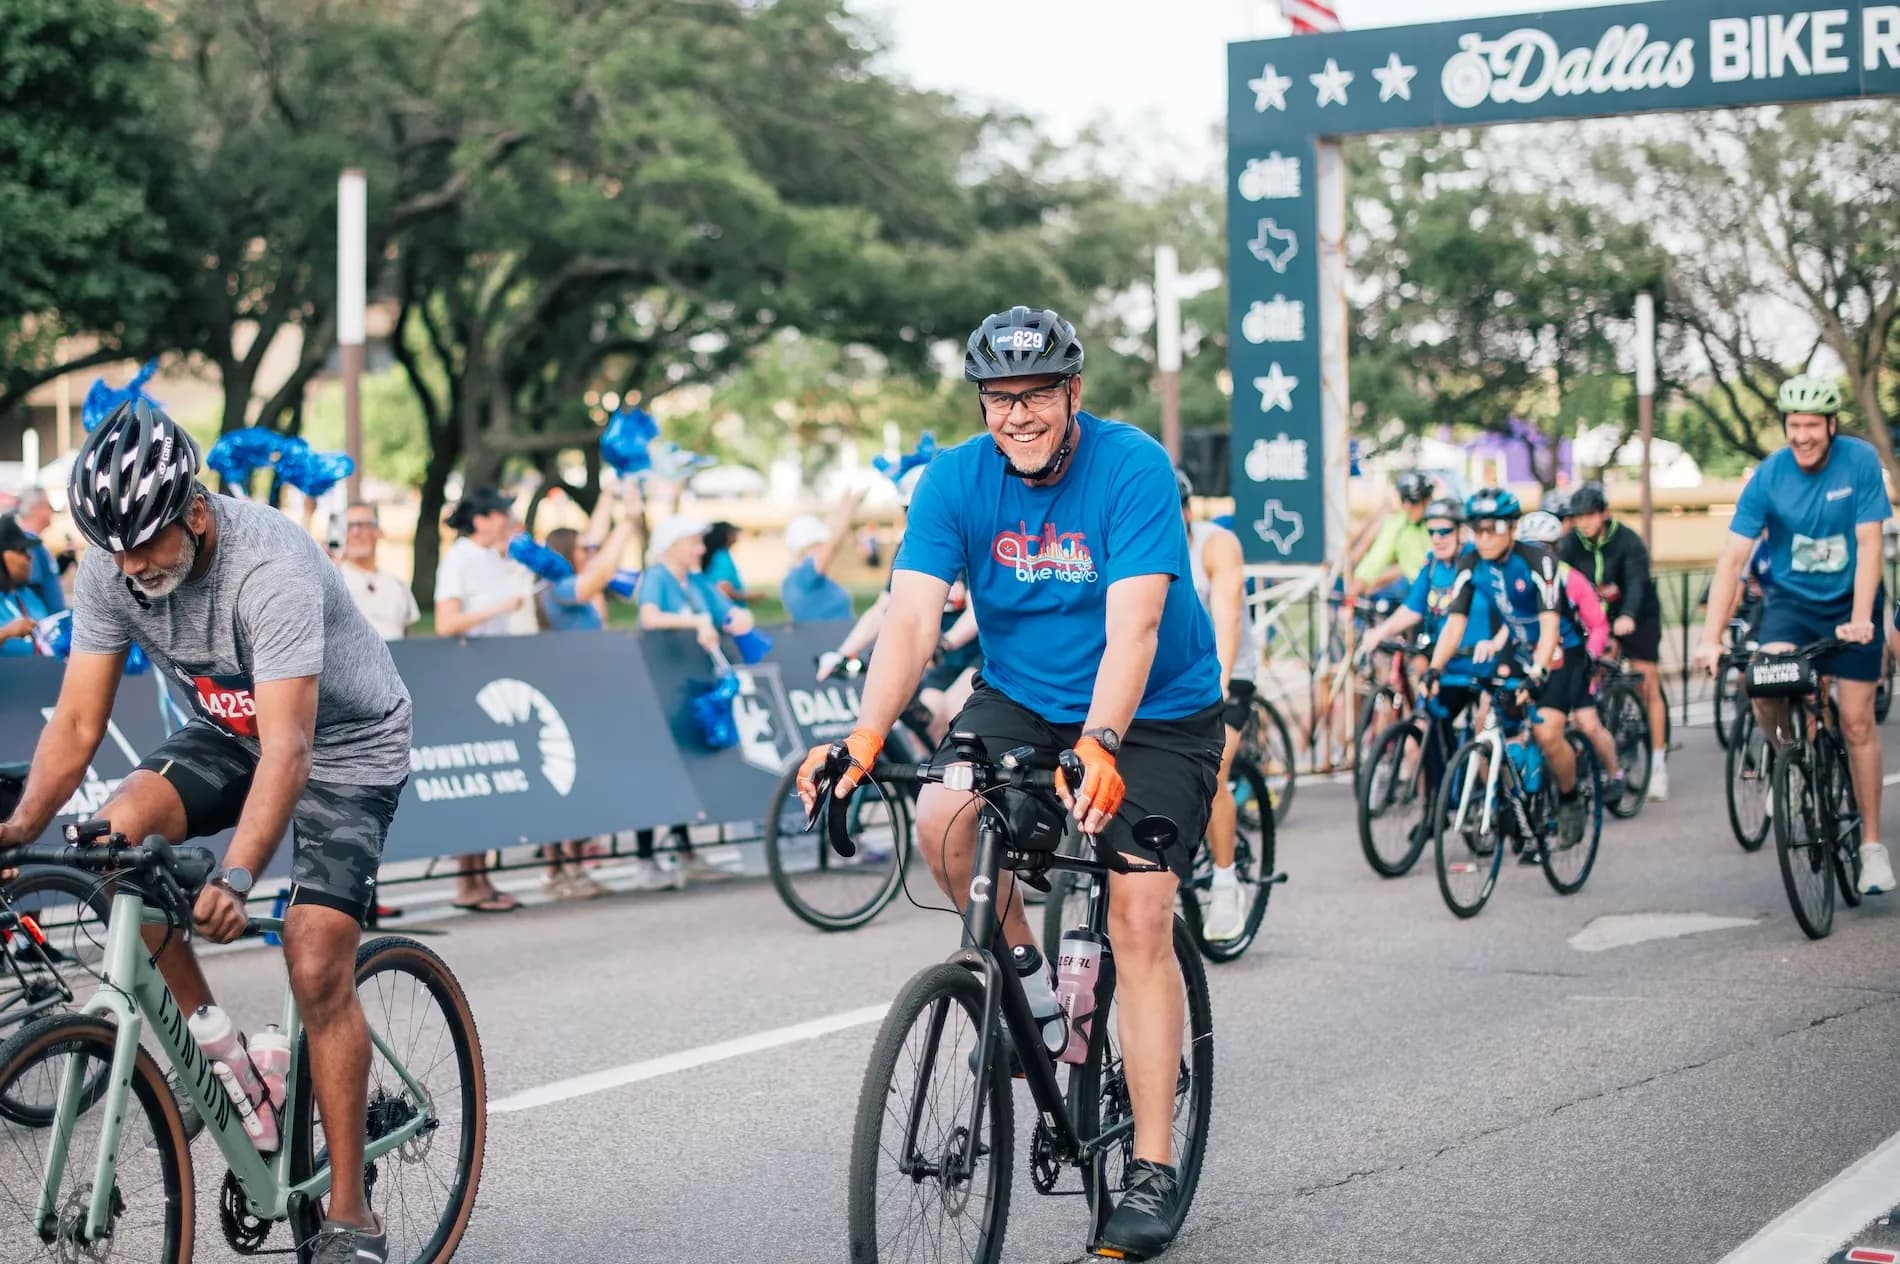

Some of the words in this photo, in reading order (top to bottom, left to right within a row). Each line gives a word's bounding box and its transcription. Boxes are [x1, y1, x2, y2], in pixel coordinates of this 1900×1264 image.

[1490, 23, 1695, 104] Dallas
[1709, 8, 1849, 83] BIKE
[1013, 330, 1043, 348] 629
[788, 686, 861, 726] DALL
[409, 738, 520, 773] DOWNTOWN
[415, 771, 492, 802] DALLAS
[491, 767, 529, 794] INC
